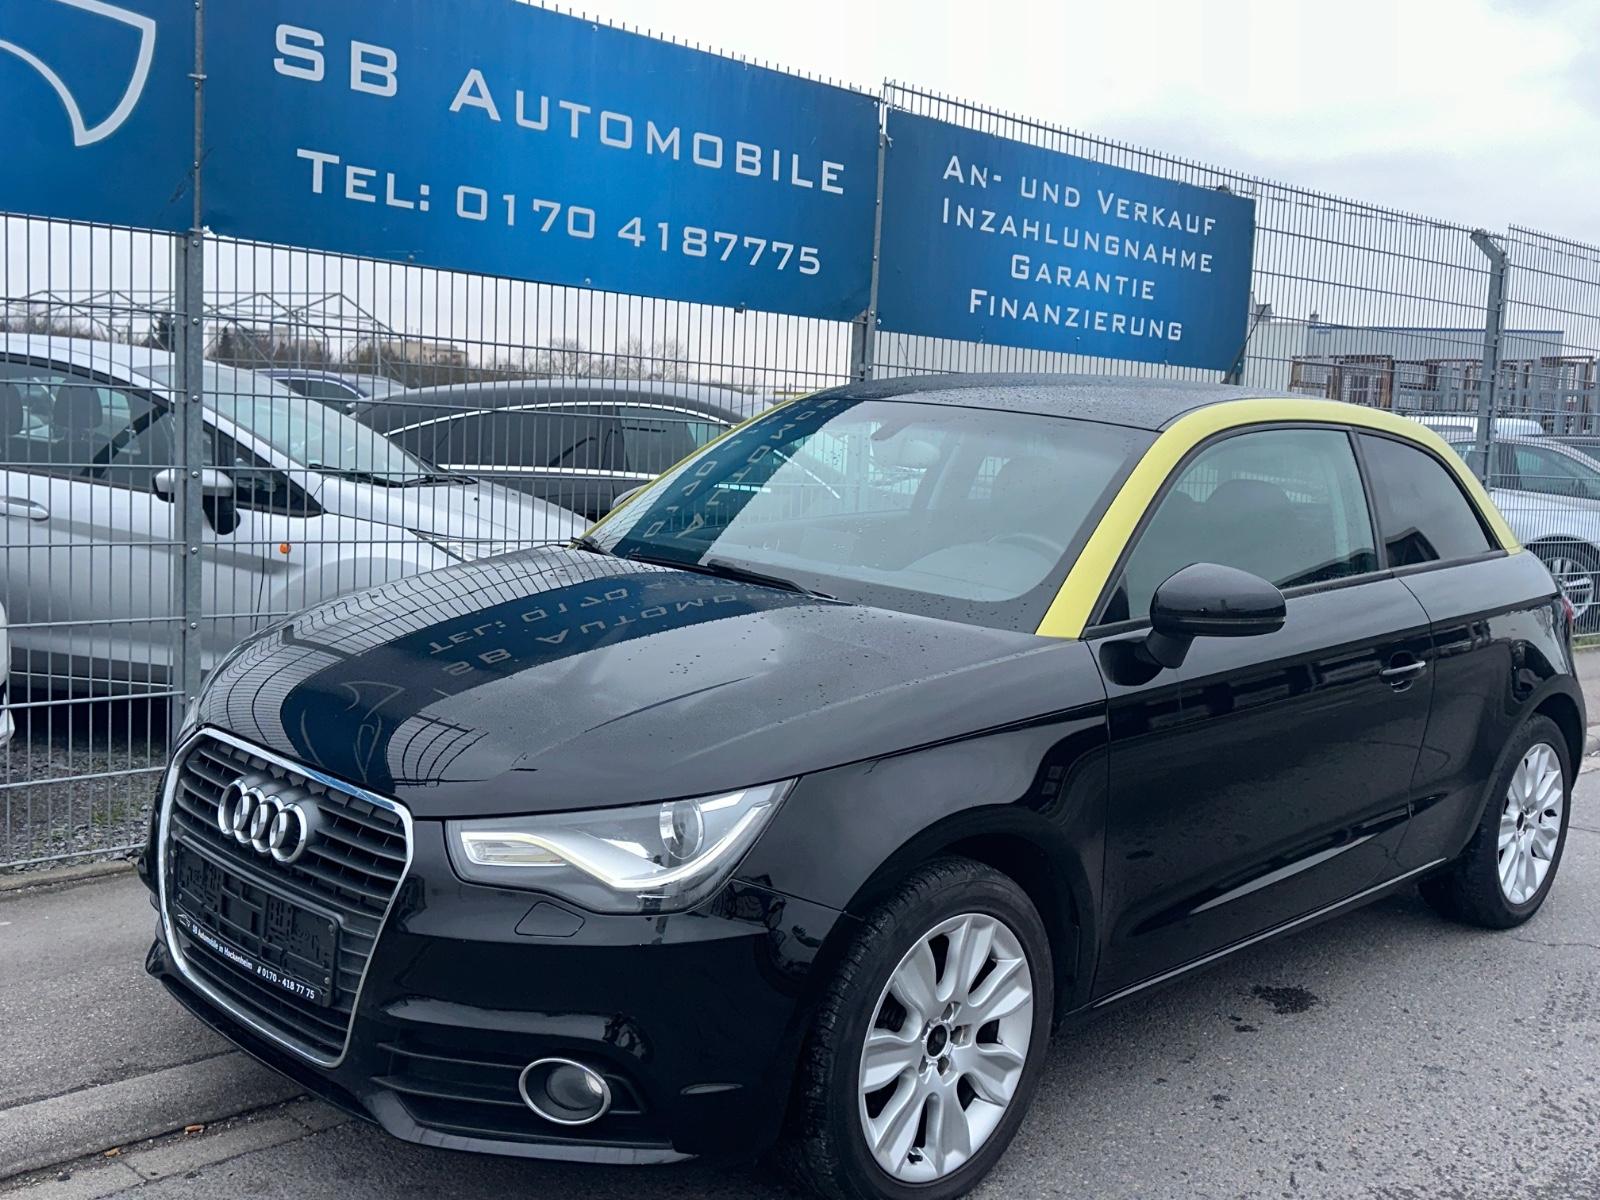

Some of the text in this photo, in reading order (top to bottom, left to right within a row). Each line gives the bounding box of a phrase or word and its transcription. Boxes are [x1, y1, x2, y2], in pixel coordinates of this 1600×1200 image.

[273, 24, 844, 195] SB AUTOMOBILE
[297, 148, 820, 275] TEL: 0170 4187775
[943, 197, 1212, 273] INZAHLUNGNAHME
[1021, 176, 1080, 208] UND
[1098, 190, 1216, 236] VERKAUF
[1011, 254, 1155, 300] GARANTIE
[970, 288, 1182, 341] FINANZIERUNG
[262, 968, 277, 983] 0170
[282, 978, 295, 990] 418
[296, 983, 305, 994] 77
[306, 988, 315, 999] 75
